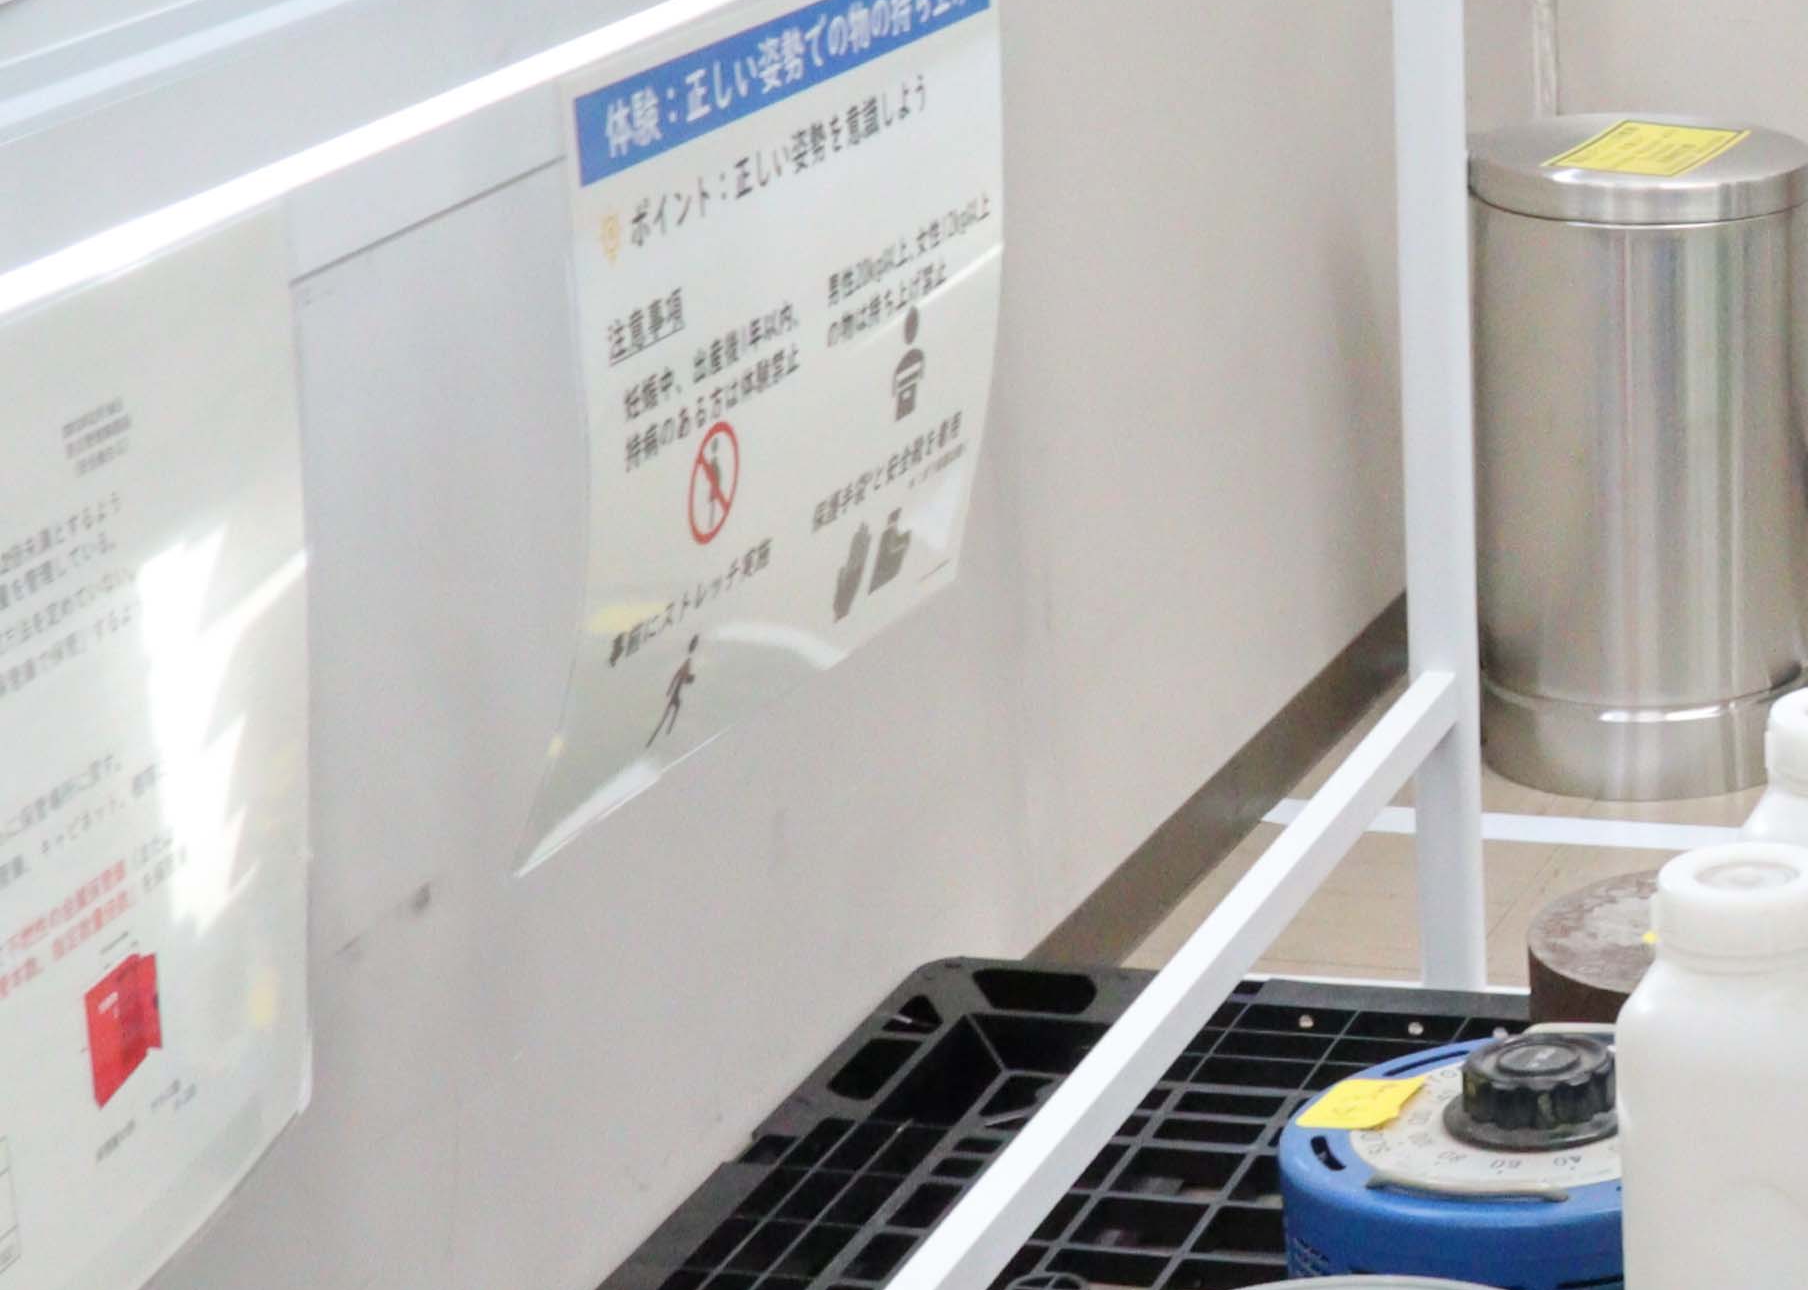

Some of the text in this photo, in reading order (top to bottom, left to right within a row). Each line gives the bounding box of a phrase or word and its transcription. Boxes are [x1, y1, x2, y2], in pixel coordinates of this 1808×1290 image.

[630, 74, 927, 247] ポイント：正しい姿勢を意識しよう
[607, 287, 685, 362] 注意事項
